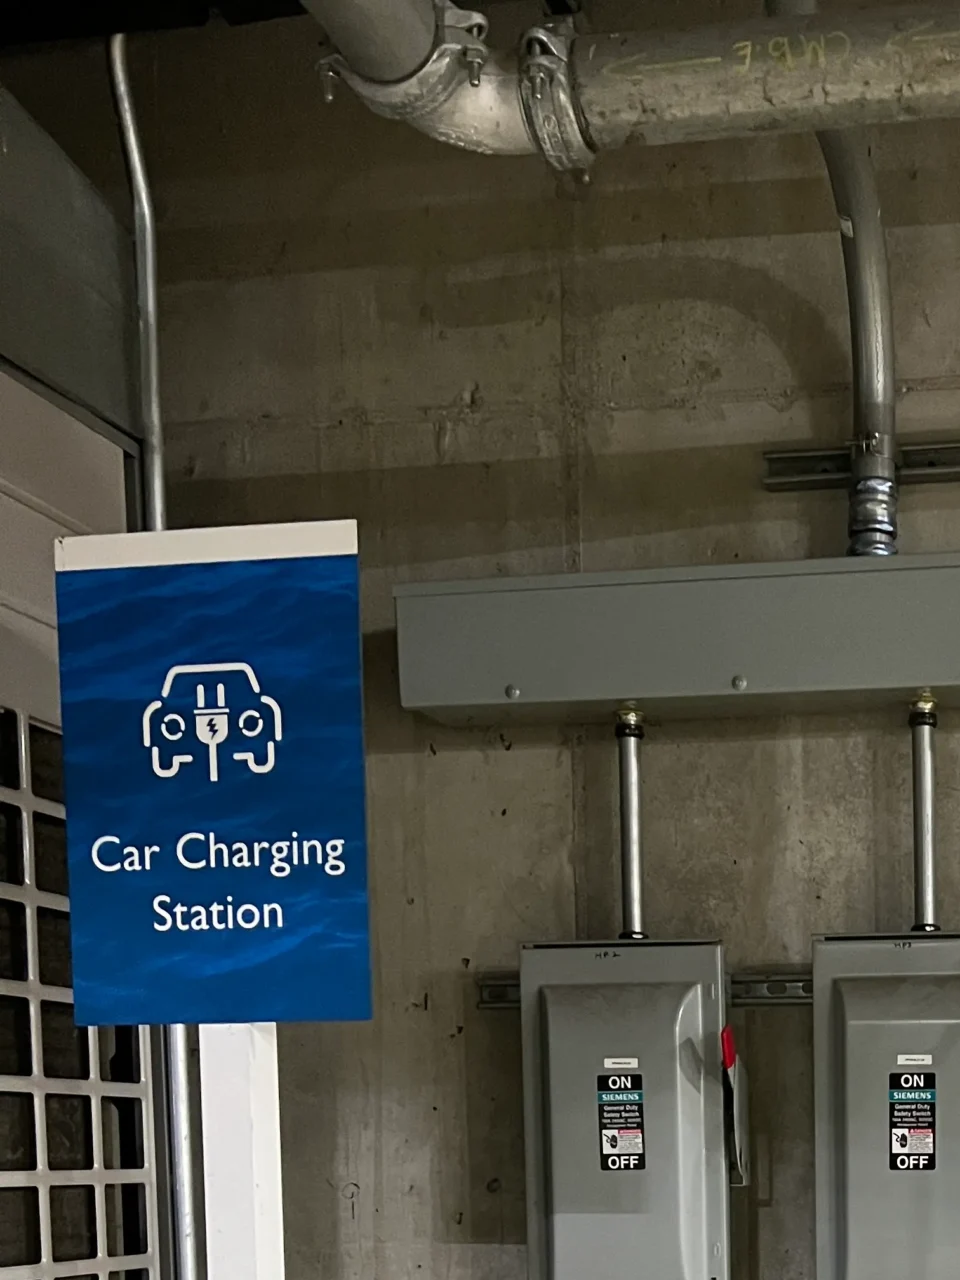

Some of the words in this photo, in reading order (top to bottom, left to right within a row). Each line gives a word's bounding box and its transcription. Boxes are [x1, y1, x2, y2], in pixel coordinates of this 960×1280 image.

[91, 835, 160, 872] Car
[176, 831, 346, 878] Charging
[153, 895, 284, 932] Station
[608, 1076, 632, 1089] ON
[900, 1074, 924, 1088] ON
[602, 1093, 640, 1101] SIEMENS
[893, 1092, 932, 1100] SIEMENS
[608, 1155, 639, 1169] OFF
[896, 1155, 929, 1169] OFF
